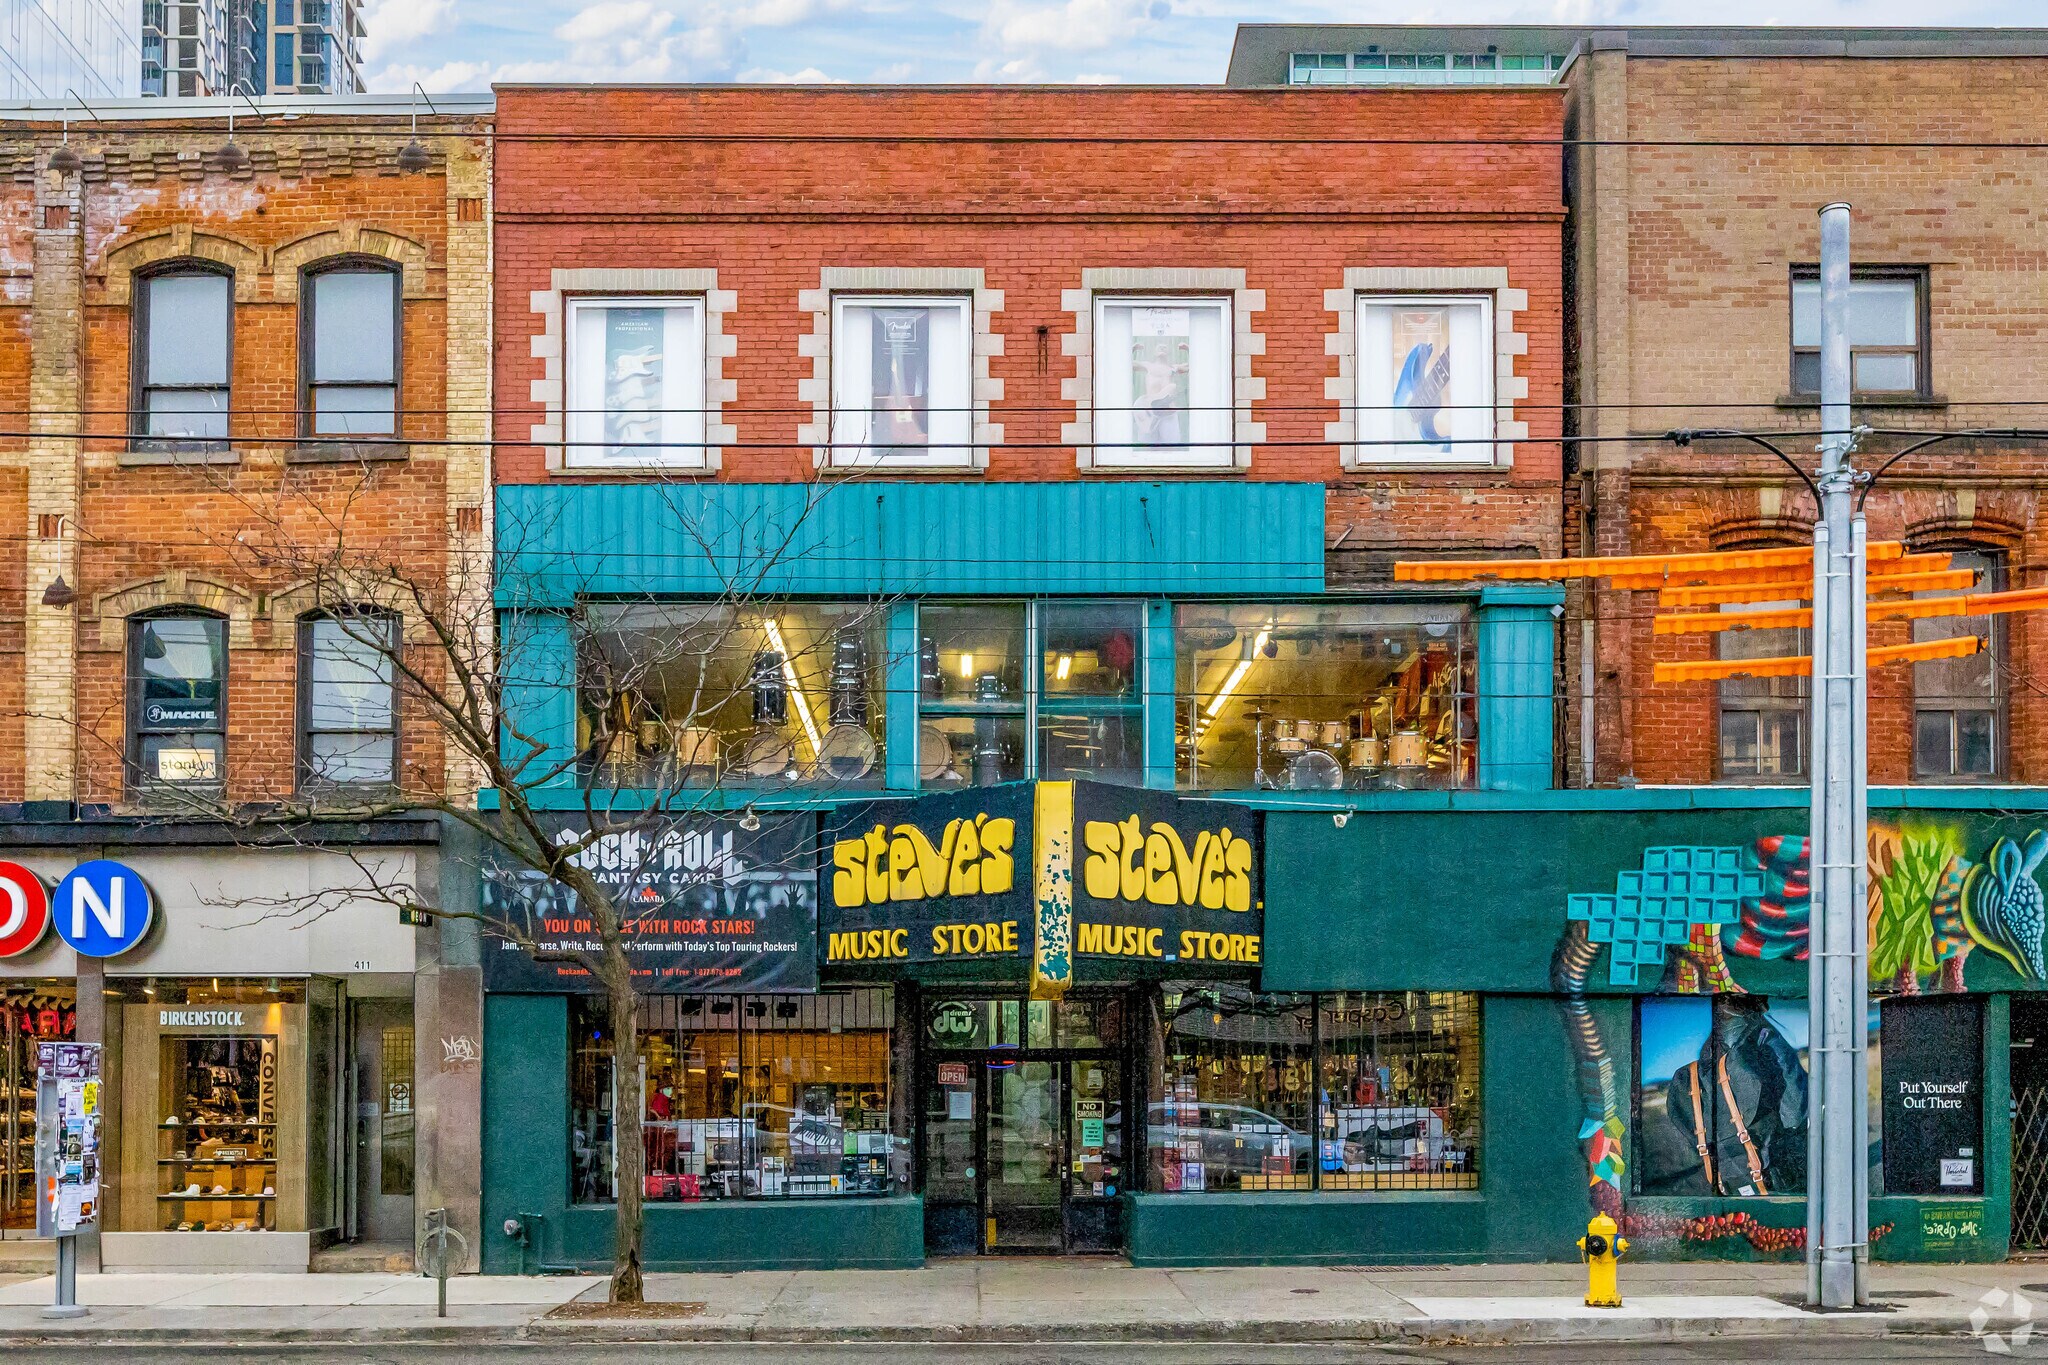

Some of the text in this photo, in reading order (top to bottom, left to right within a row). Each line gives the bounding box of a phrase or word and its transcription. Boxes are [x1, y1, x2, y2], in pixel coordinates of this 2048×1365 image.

[161, 759, 215, 770] stanton
[664, 829, 743, 886] ROLL
[669, 873, 716, 884] CAMP
[544, 919, 570, 933] YOU
[574, 920, 591, 933] ON
[639, 920, 669, 934] WITH
[673, 920, 707, 934] ROCK
[712, 920, 755, 934] STARS!
[501, 940, 519, 951] Jam,
[521, 940, 559, 951] arse,
[561, 940, 584, 951] Write,
[665, 941, 682, 951] with
[684, 941, 714, 952] Today's
[715, 942, 730, 953] Top
[732, 942, 762, 953] Touring
[763, 942, 798, 952] Rockers!
[828, 920, 1018, 961] MUSIC STORE
[1077, 923, 1260, 963] MUSIC STORE
[354, 961, 370, 970] 411
[941, 1071, 965, 1082] OPEN
[1900, 1081, 1968, 1094] Put Yourself
[1903, 1097, 1962, 1109] Out There
[1077, 1110, 1102, 1118] SMOKING
